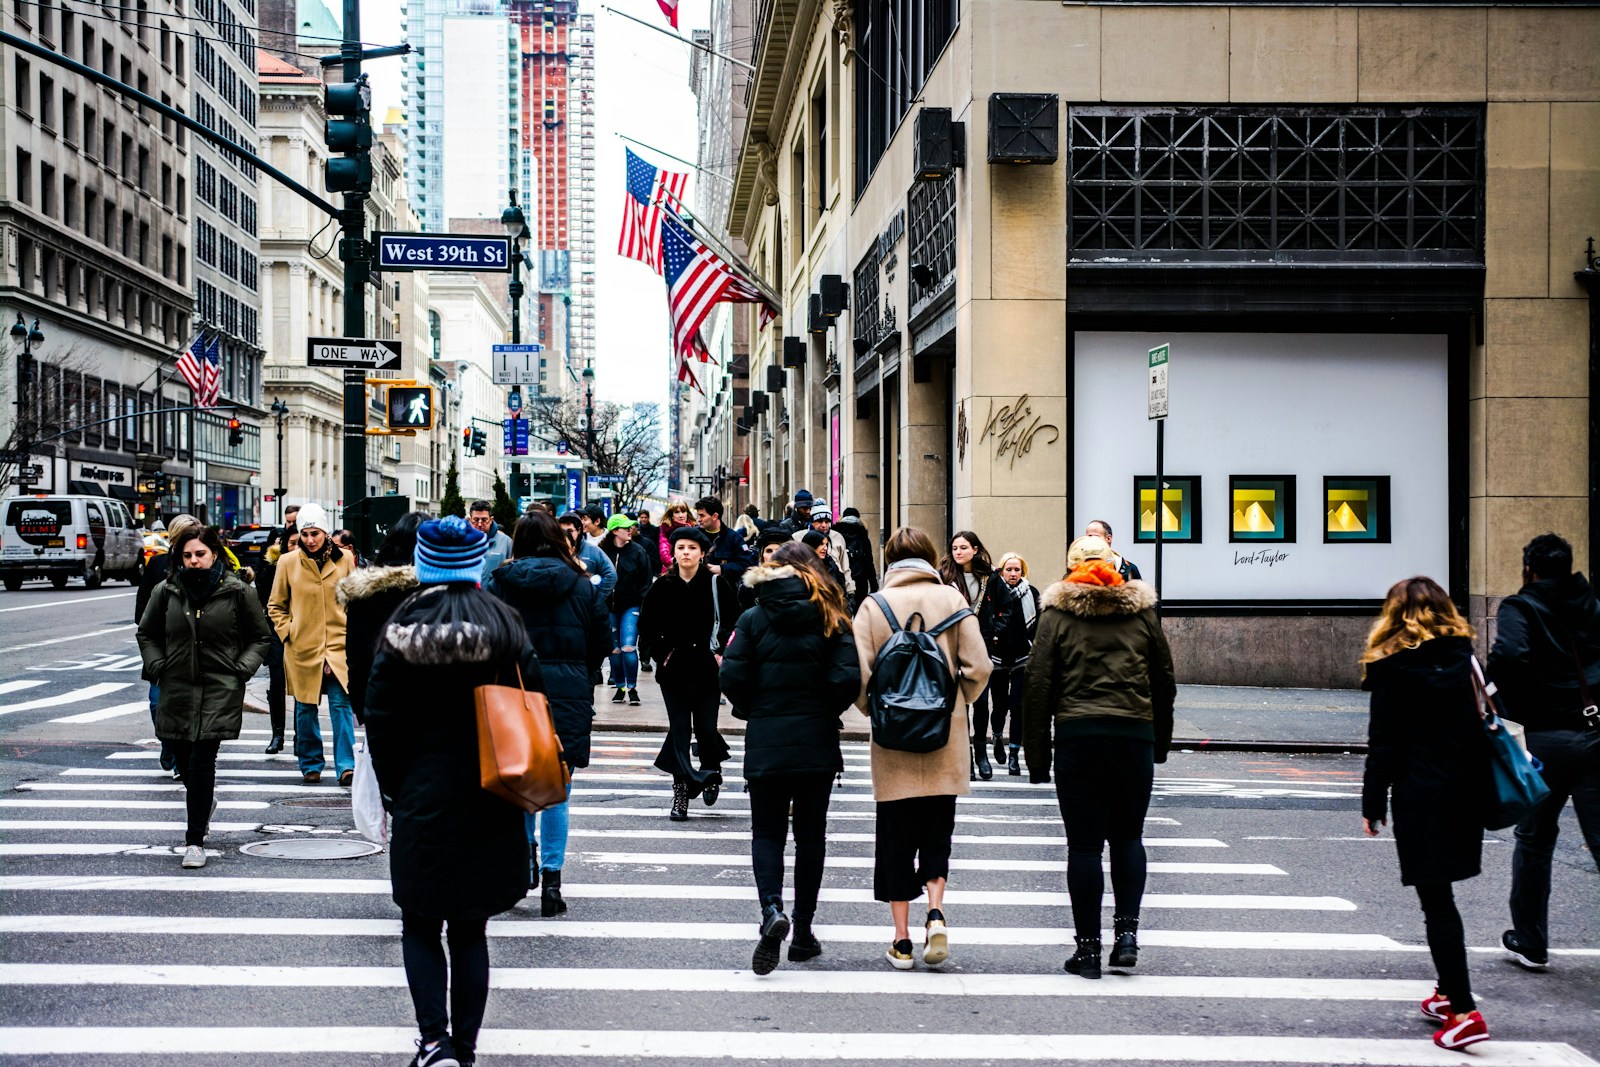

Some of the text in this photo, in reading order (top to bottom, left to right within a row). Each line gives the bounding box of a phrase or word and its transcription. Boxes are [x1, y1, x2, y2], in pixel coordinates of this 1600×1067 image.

[385, 243, 503, 262] West 39th St
[321, 347, 388, 361] ONE WAY
[1234, 551, 1255, 565] Lord
[1258, 549, 1290, 567] Taylor
